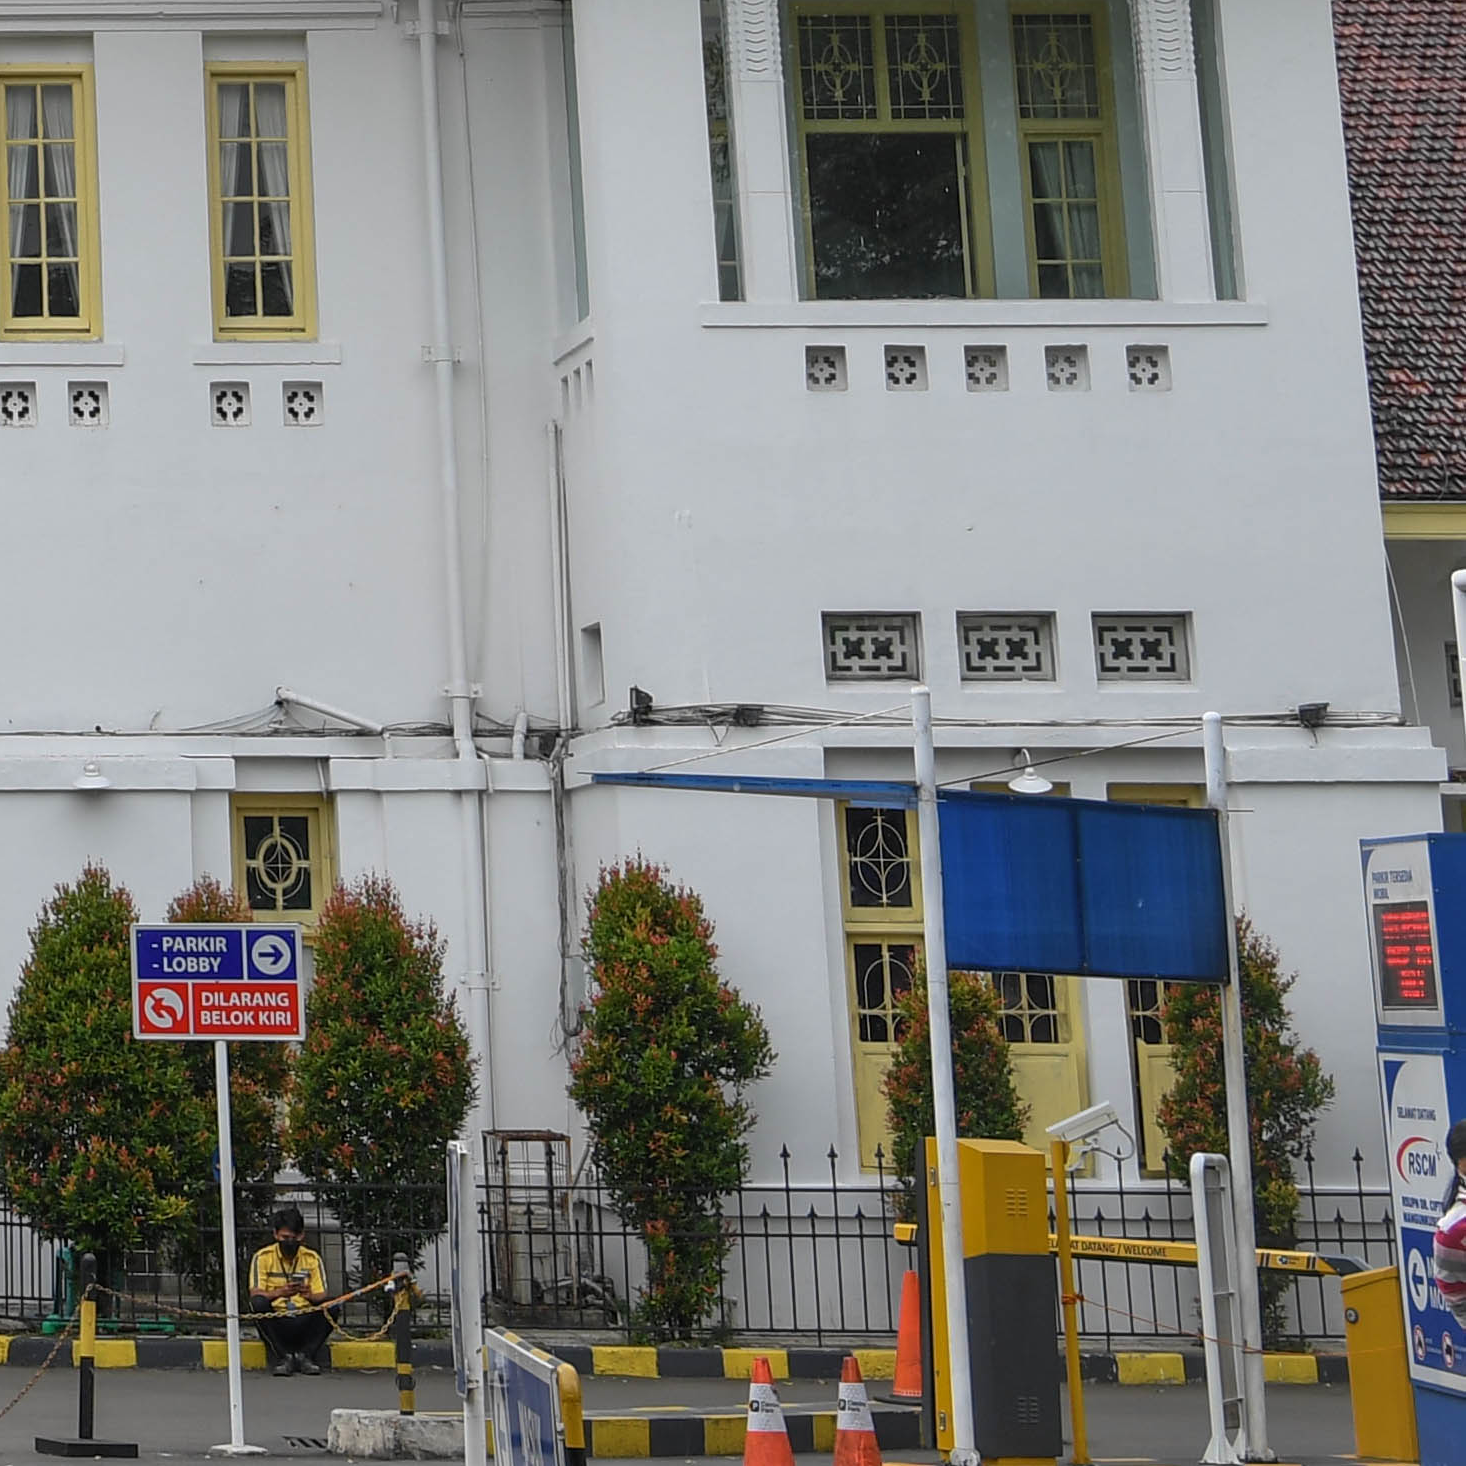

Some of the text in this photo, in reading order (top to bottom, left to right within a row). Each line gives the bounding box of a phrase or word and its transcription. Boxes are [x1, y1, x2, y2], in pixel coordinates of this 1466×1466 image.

[162, 936, 227, 953] PARKIR
[163, 956, 221, 973] LOBBY
[201, 991, 290, 1007] DILARANG
[200, 1010, 291, 1026] BELOK KIRI
[1408, 1152, 1437, 1177] RSCM
[1081, 1240, 1115, 1253] DATANG
[1124, 1244, 1167, 1257] WELCOME
